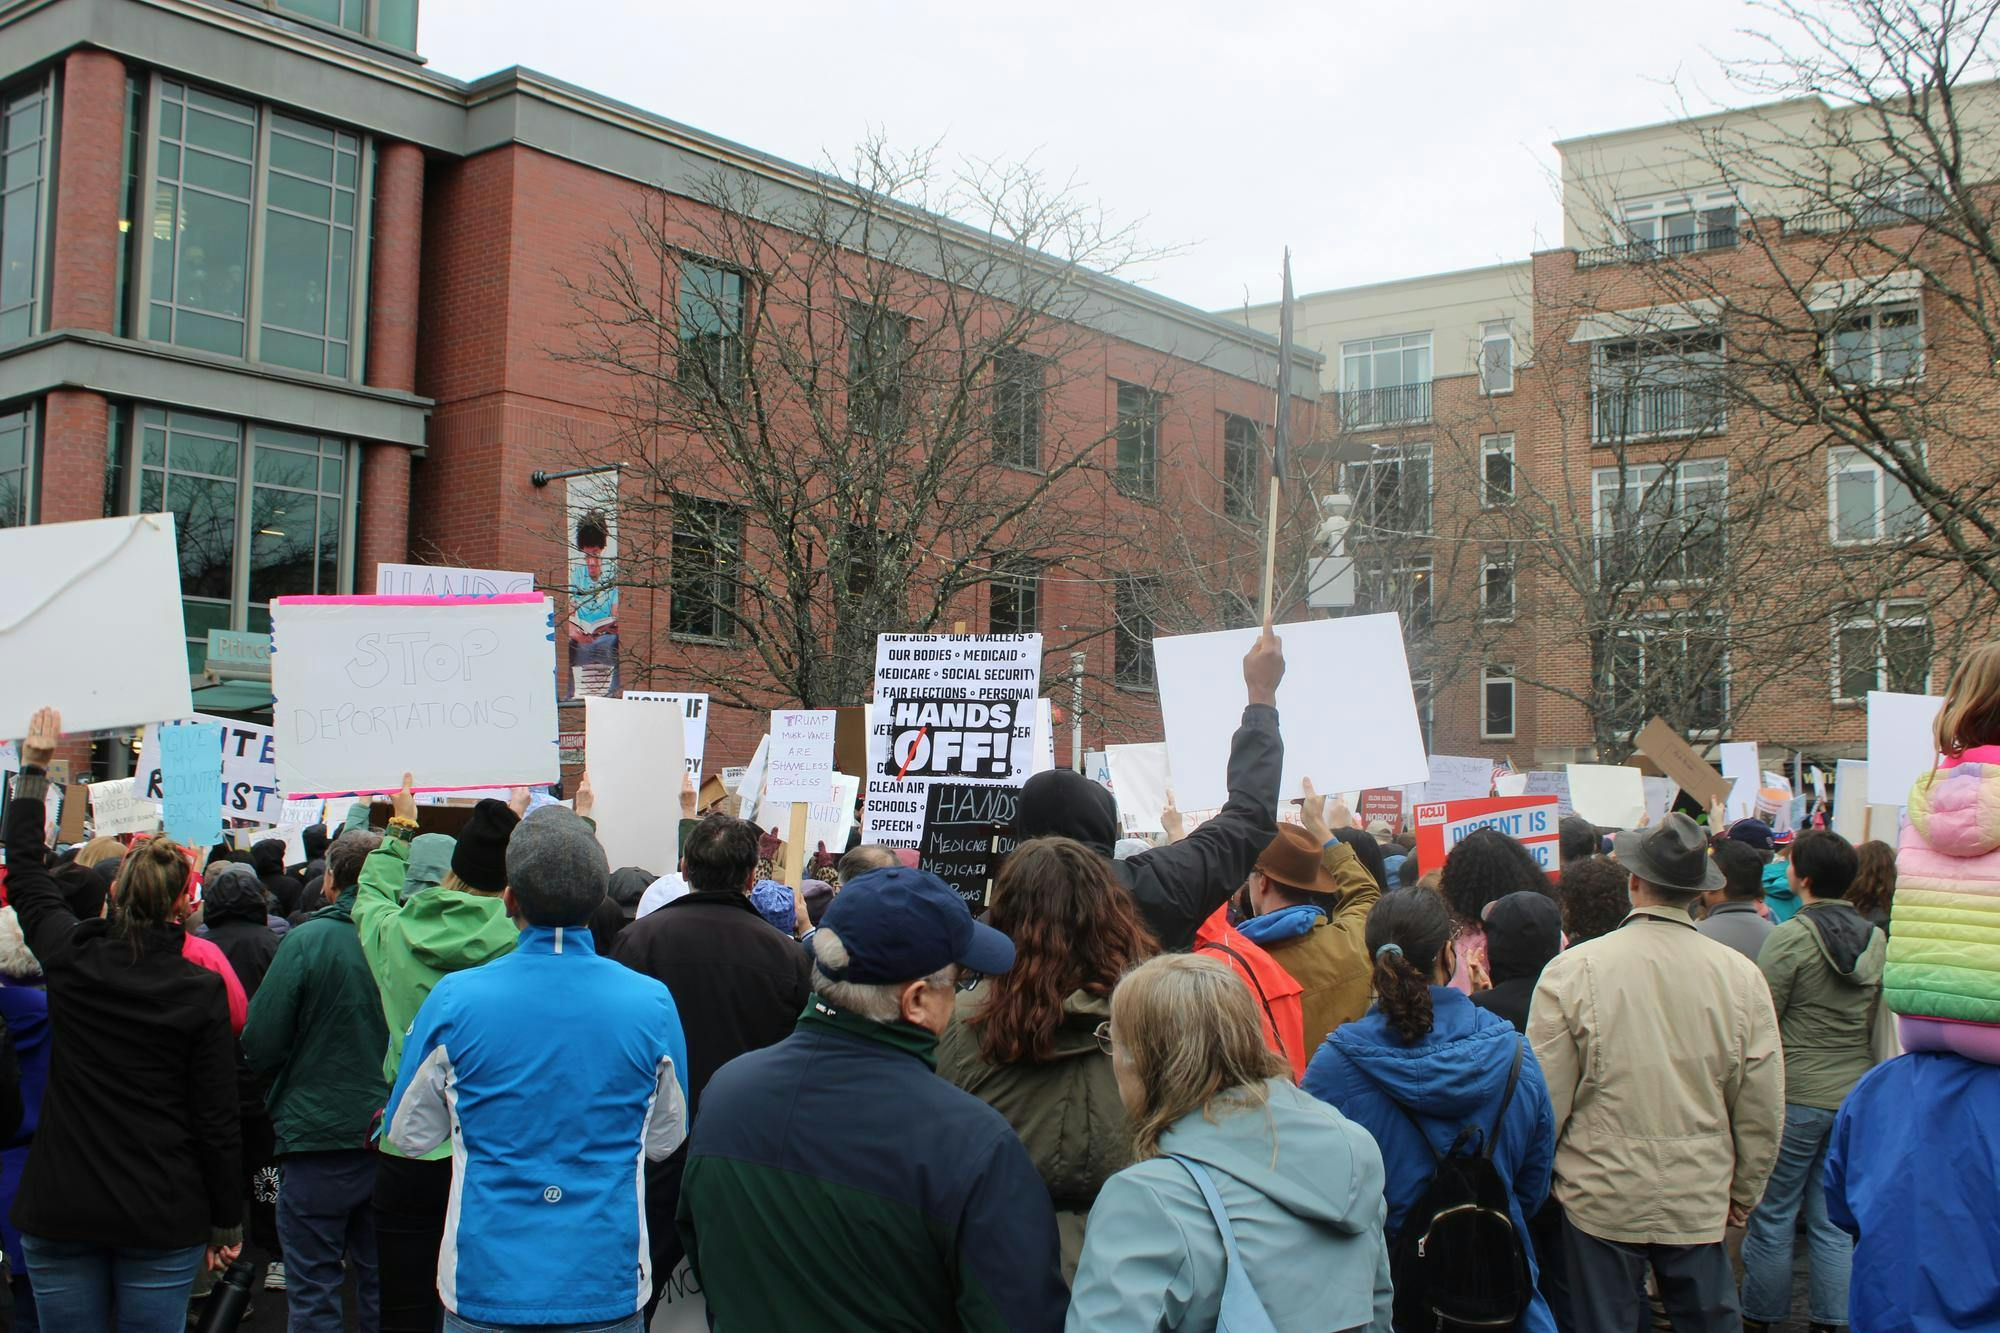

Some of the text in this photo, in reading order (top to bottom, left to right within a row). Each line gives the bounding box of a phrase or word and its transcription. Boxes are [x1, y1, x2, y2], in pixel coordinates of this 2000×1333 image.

[344, 628, 499, 688] STOP
[889, 650, 1017, 661] OUR BODIES MEDICAID
[878, 669, 1034, 681] MEDICARE SOCIAL SECURITY
[883, 687, 908, 698] FAIR
[911, 687, 967, 699] ELECTIONS
[686, 698, 703, 718] IF
[895, 702, 1011, 728] HANDS
[784, 715, 829, 727] TRUMP
[166, 728, 209, 752] GIVE
[789, 747, 812, 756] ARE
[893, 729, 1009, 773] OFF!
[173, 754, 197, 769] MY
[772, 761, 828, 771] SHAMELESS
[164, 770, 221, 797] COUNTRY
[773, 778, 820, 786] RECKLESS
[869, 781, 905, 793] CLEAN
[907, 782, 924, 793] AIR
[868, 800, 917, 813] SCHOOLS
[936, 788, 1019, 822] HANDS
[1420, 806, 1445, 819] ACLU
[167, 800, 213, 826] BACK!
[808, 803, 841, 824] IGHTS
[871, 820, 913, 832] SPEECH
[1530, 811, 1546, 832] IS
[930, 831, 987, 854] MEDICARE
